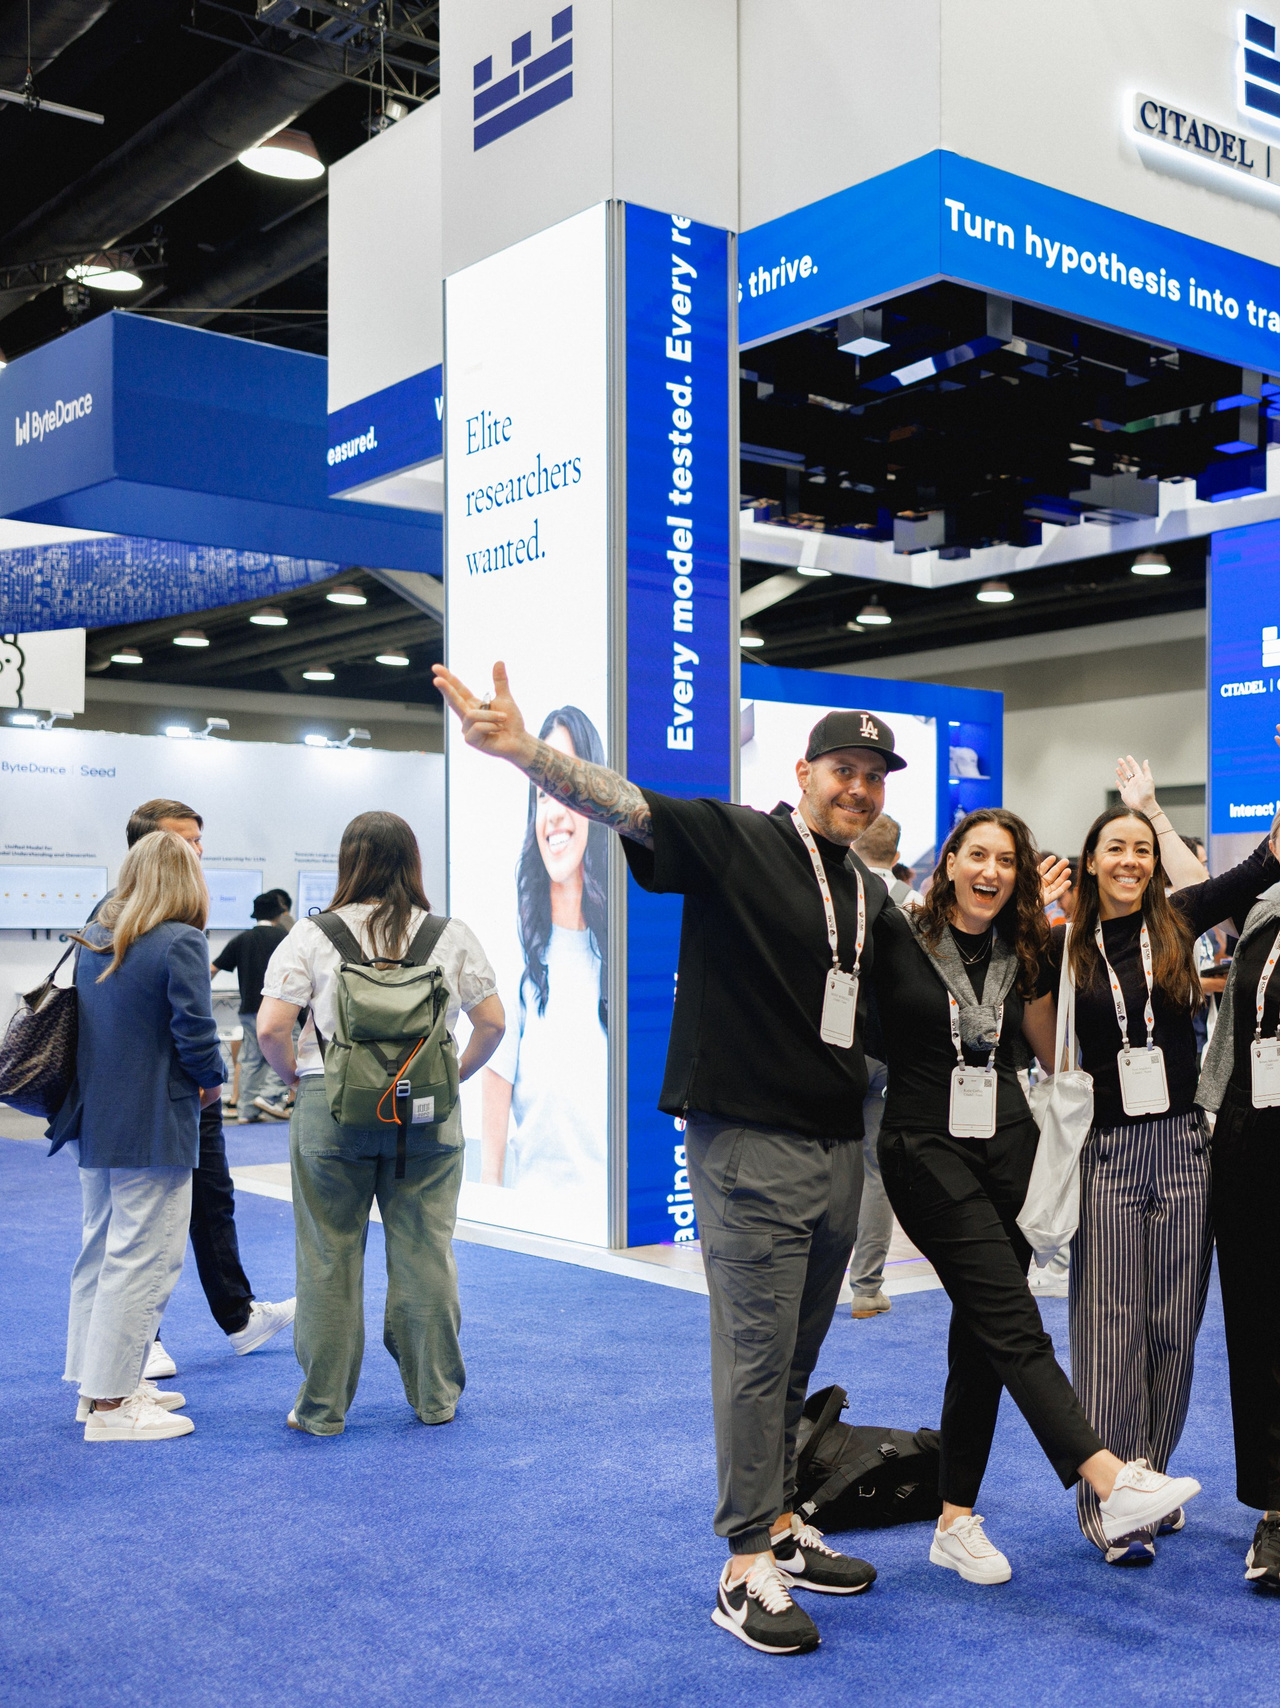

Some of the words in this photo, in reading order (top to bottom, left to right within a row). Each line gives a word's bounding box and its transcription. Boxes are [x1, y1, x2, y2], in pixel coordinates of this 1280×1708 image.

[1139, 99, 1254, 169] CITADEL
[748, 254, 819, 298] thrive.
[944, 197, 1015, 250] Turn
[1025, 224, 1182, 302] hypothesis
[1188, 278, 1240, 321] into
[666, 253, 698, 363] Every
[32, 393, 93, 442] ByteDance
[466, 409, 512, 456] Elite
[666, 374, 694, 506] tested.
[466, 452, 582, 517] researchers
[466, 518, 546, 577] wanted.
[666, 516, 694, 634] model
[666, 639, 700, 752] Every
[1220, 680, 1267, 698] CITADEL
[859, 714, 880, 741] LA
[1, 761, 67, 775] ByteDance
[80, 765, 117, 778] Seed
[1229, 803, 1275, 819] Interact
